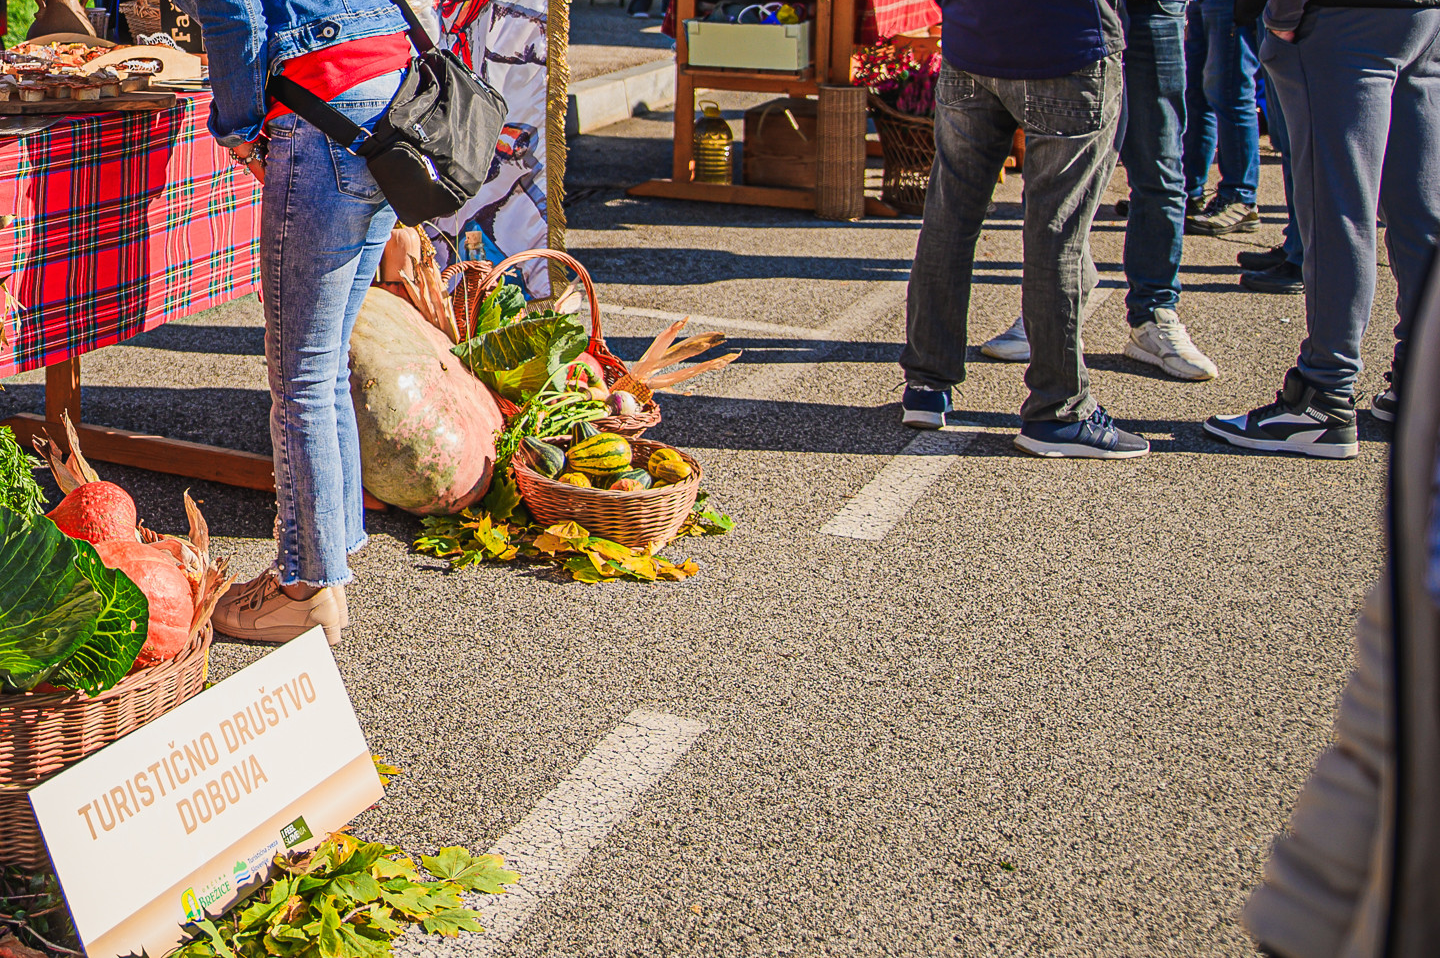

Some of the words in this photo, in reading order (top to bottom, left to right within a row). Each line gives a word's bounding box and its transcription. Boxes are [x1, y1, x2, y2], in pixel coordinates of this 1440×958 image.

[1305, 406, 1329, 423] PUMA
[77, 730, 220, 841] TURISTIČNO
[218, 670, 318, 754] DRUŠTVO
[176, 753, 269, 835] DOBOVA
[247, 848, 268, 865] Turistična
[266, 839, 279, 852] zveza
[198, 880, 231, 910] BREŽICE
